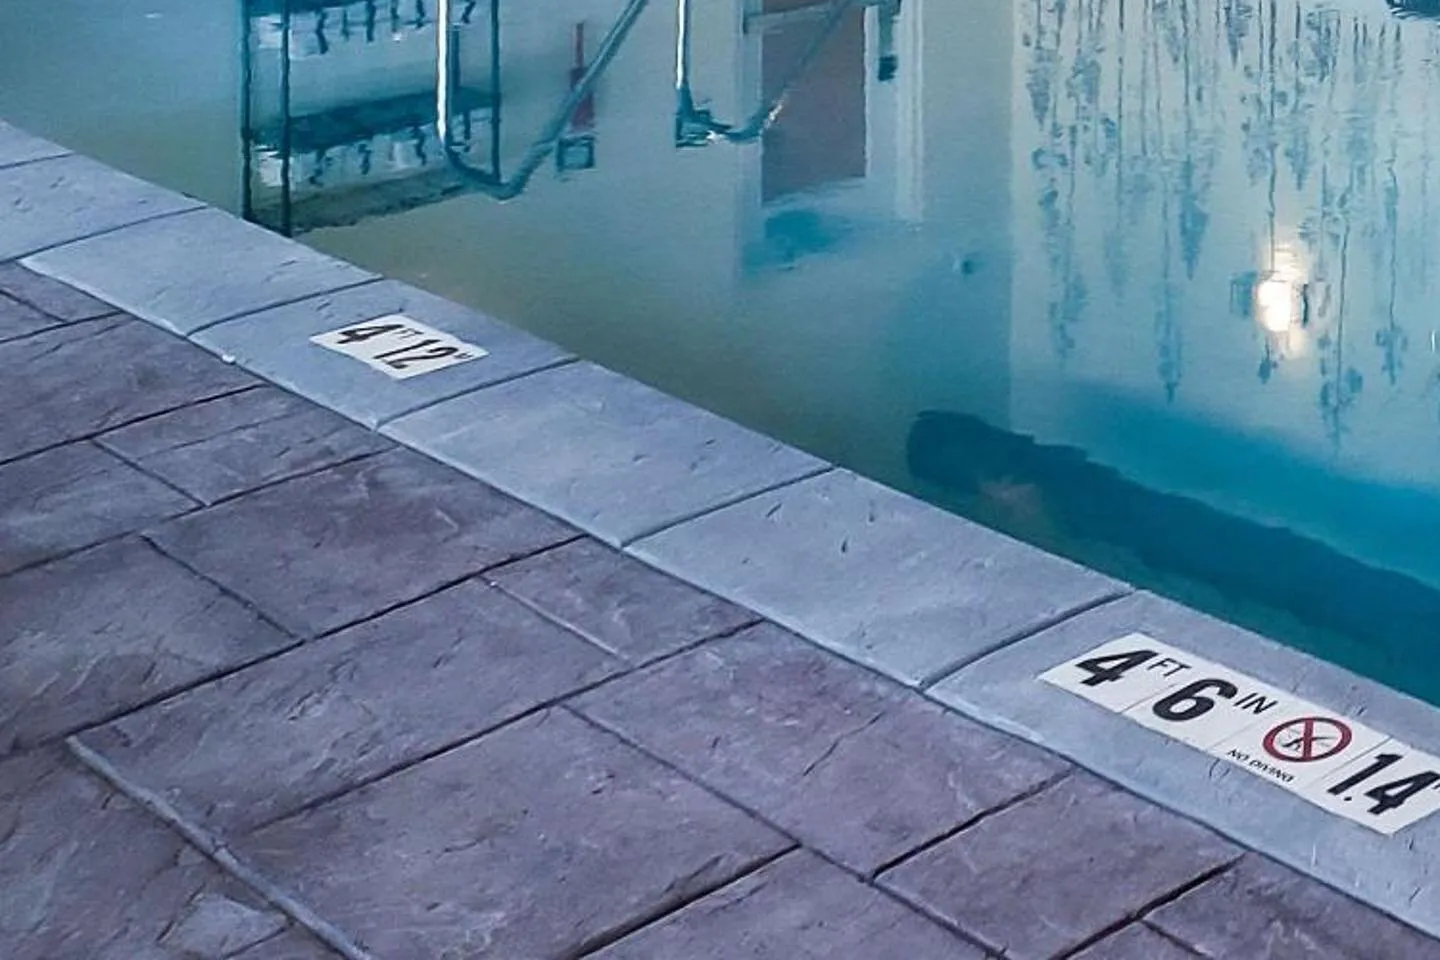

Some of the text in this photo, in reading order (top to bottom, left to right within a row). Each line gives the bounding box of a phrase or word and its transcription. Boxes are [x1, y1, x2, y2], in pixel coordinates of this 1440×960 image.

[337, 324, 404, 344] 4
[1074, 649, 1159, 687] 4
[1147, 658, 1193, 677] FT
[1152, 678, 1239, 722] 6
[1234, 692, 1279, 715] IN
[1227, 747, 1296, 784] NO DIVING
